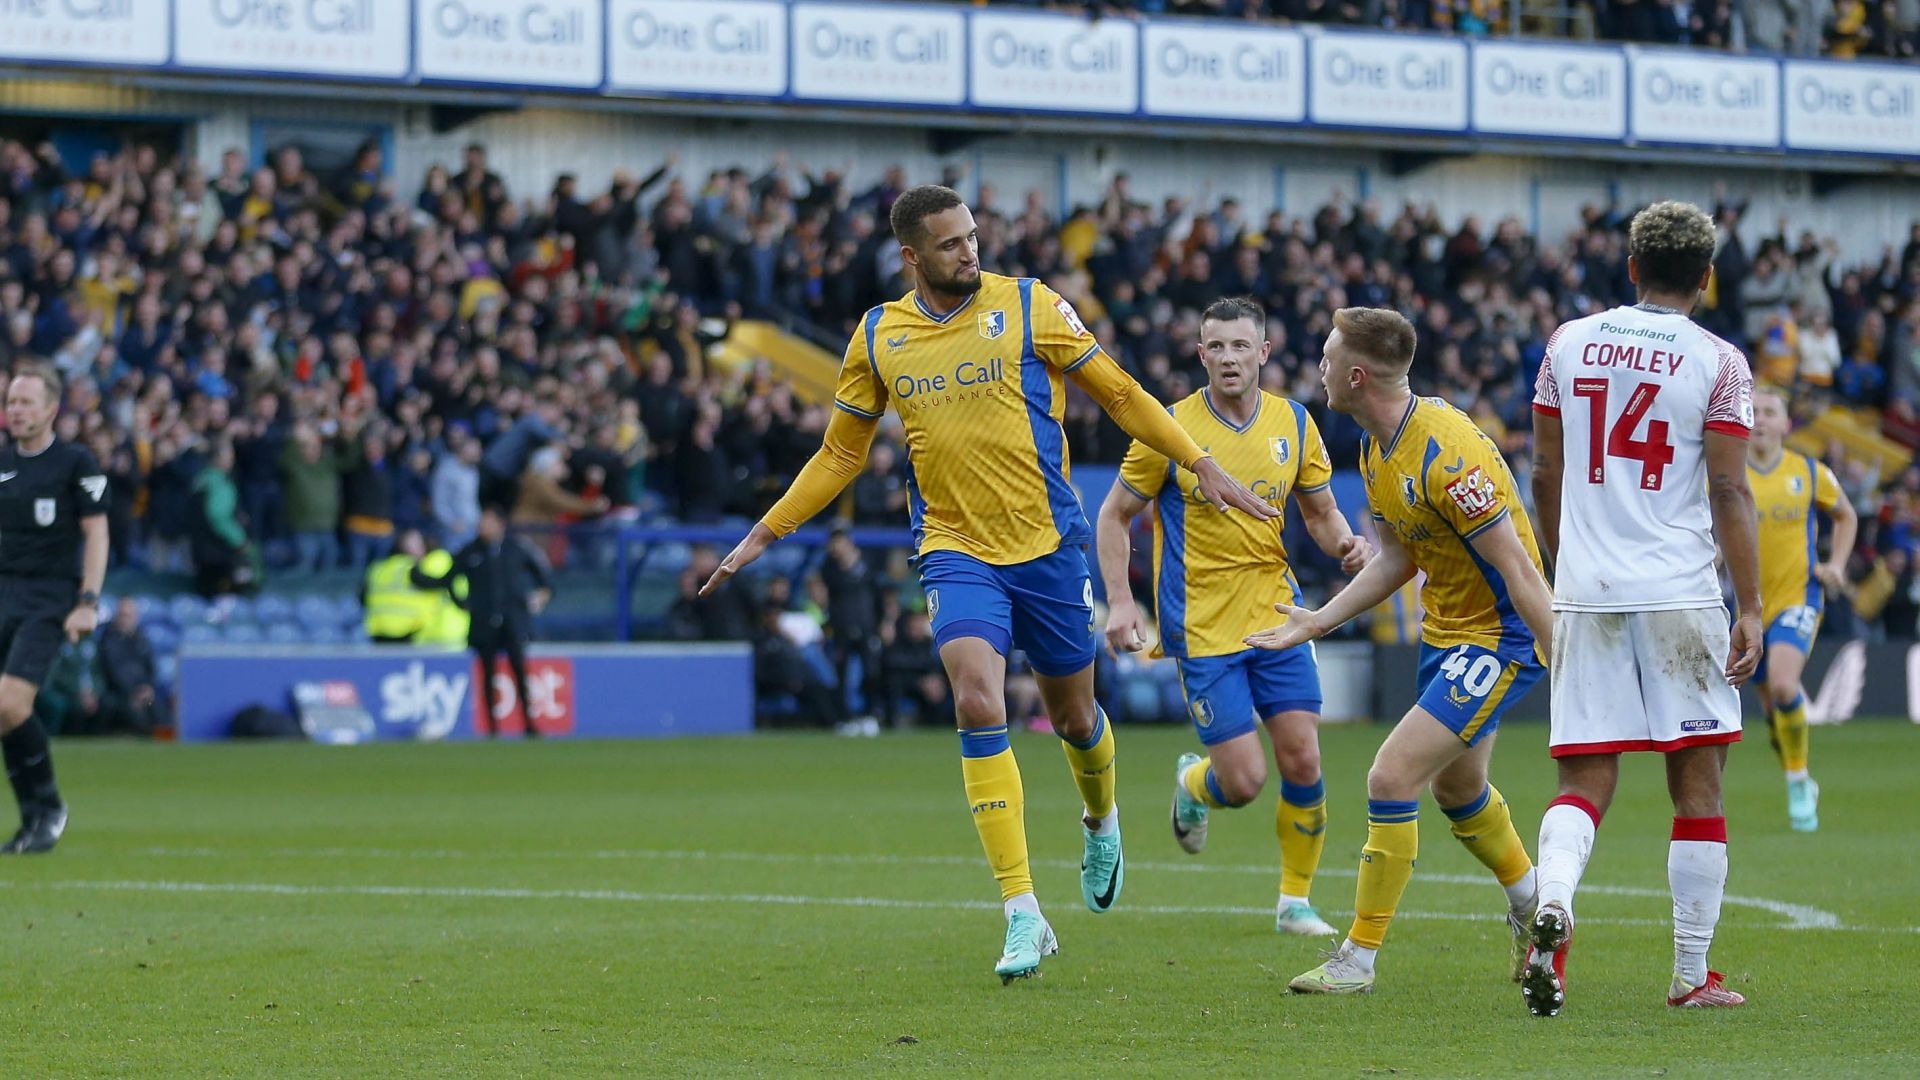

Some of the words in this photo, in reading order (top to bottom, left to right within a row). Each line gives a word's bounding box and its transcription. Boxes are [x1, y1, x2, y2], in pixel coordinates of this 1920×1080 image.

[214, 0, 292, 31] One
[304, 0, 374, 34] Call
[435, 0, 505, 41] One
[519, 3, 583, 46] Call
[625, 10, 696, 52] One
[704, 14, 769, 55] Call
[806, 19, 877, 61] One
[886, 23, 949, 64] Call
[984, 29, 1053, 70] One
[1061, 33, 1122, 73] Call
[1157, 38, 1222, 79] One
[1231, 43, 1289, 82] Call
[1324, 48, 1388, 88] One
[1396, 52, 1453, 91] Call
[1486, 58, 1548, 98] One
[1556, 62, 1610, 102] Call
[1645, 66, 1706, 106] One
[1714, 69, 1766, 109] Call
[1797, 75, 1857, 115] One
[1863, 79, 1914, 119] Call
[1600, 323, 1677, 342] Poundland
[895, 375, 946, 399] One
[955, 357, 1003, 385] Call
[1582, 343, 1685, 376] COMLEY
[1573, 378, 1675, 491] 14
[1440, 644, 1502, 697] 40
[381, 661, 469, 741] sky
